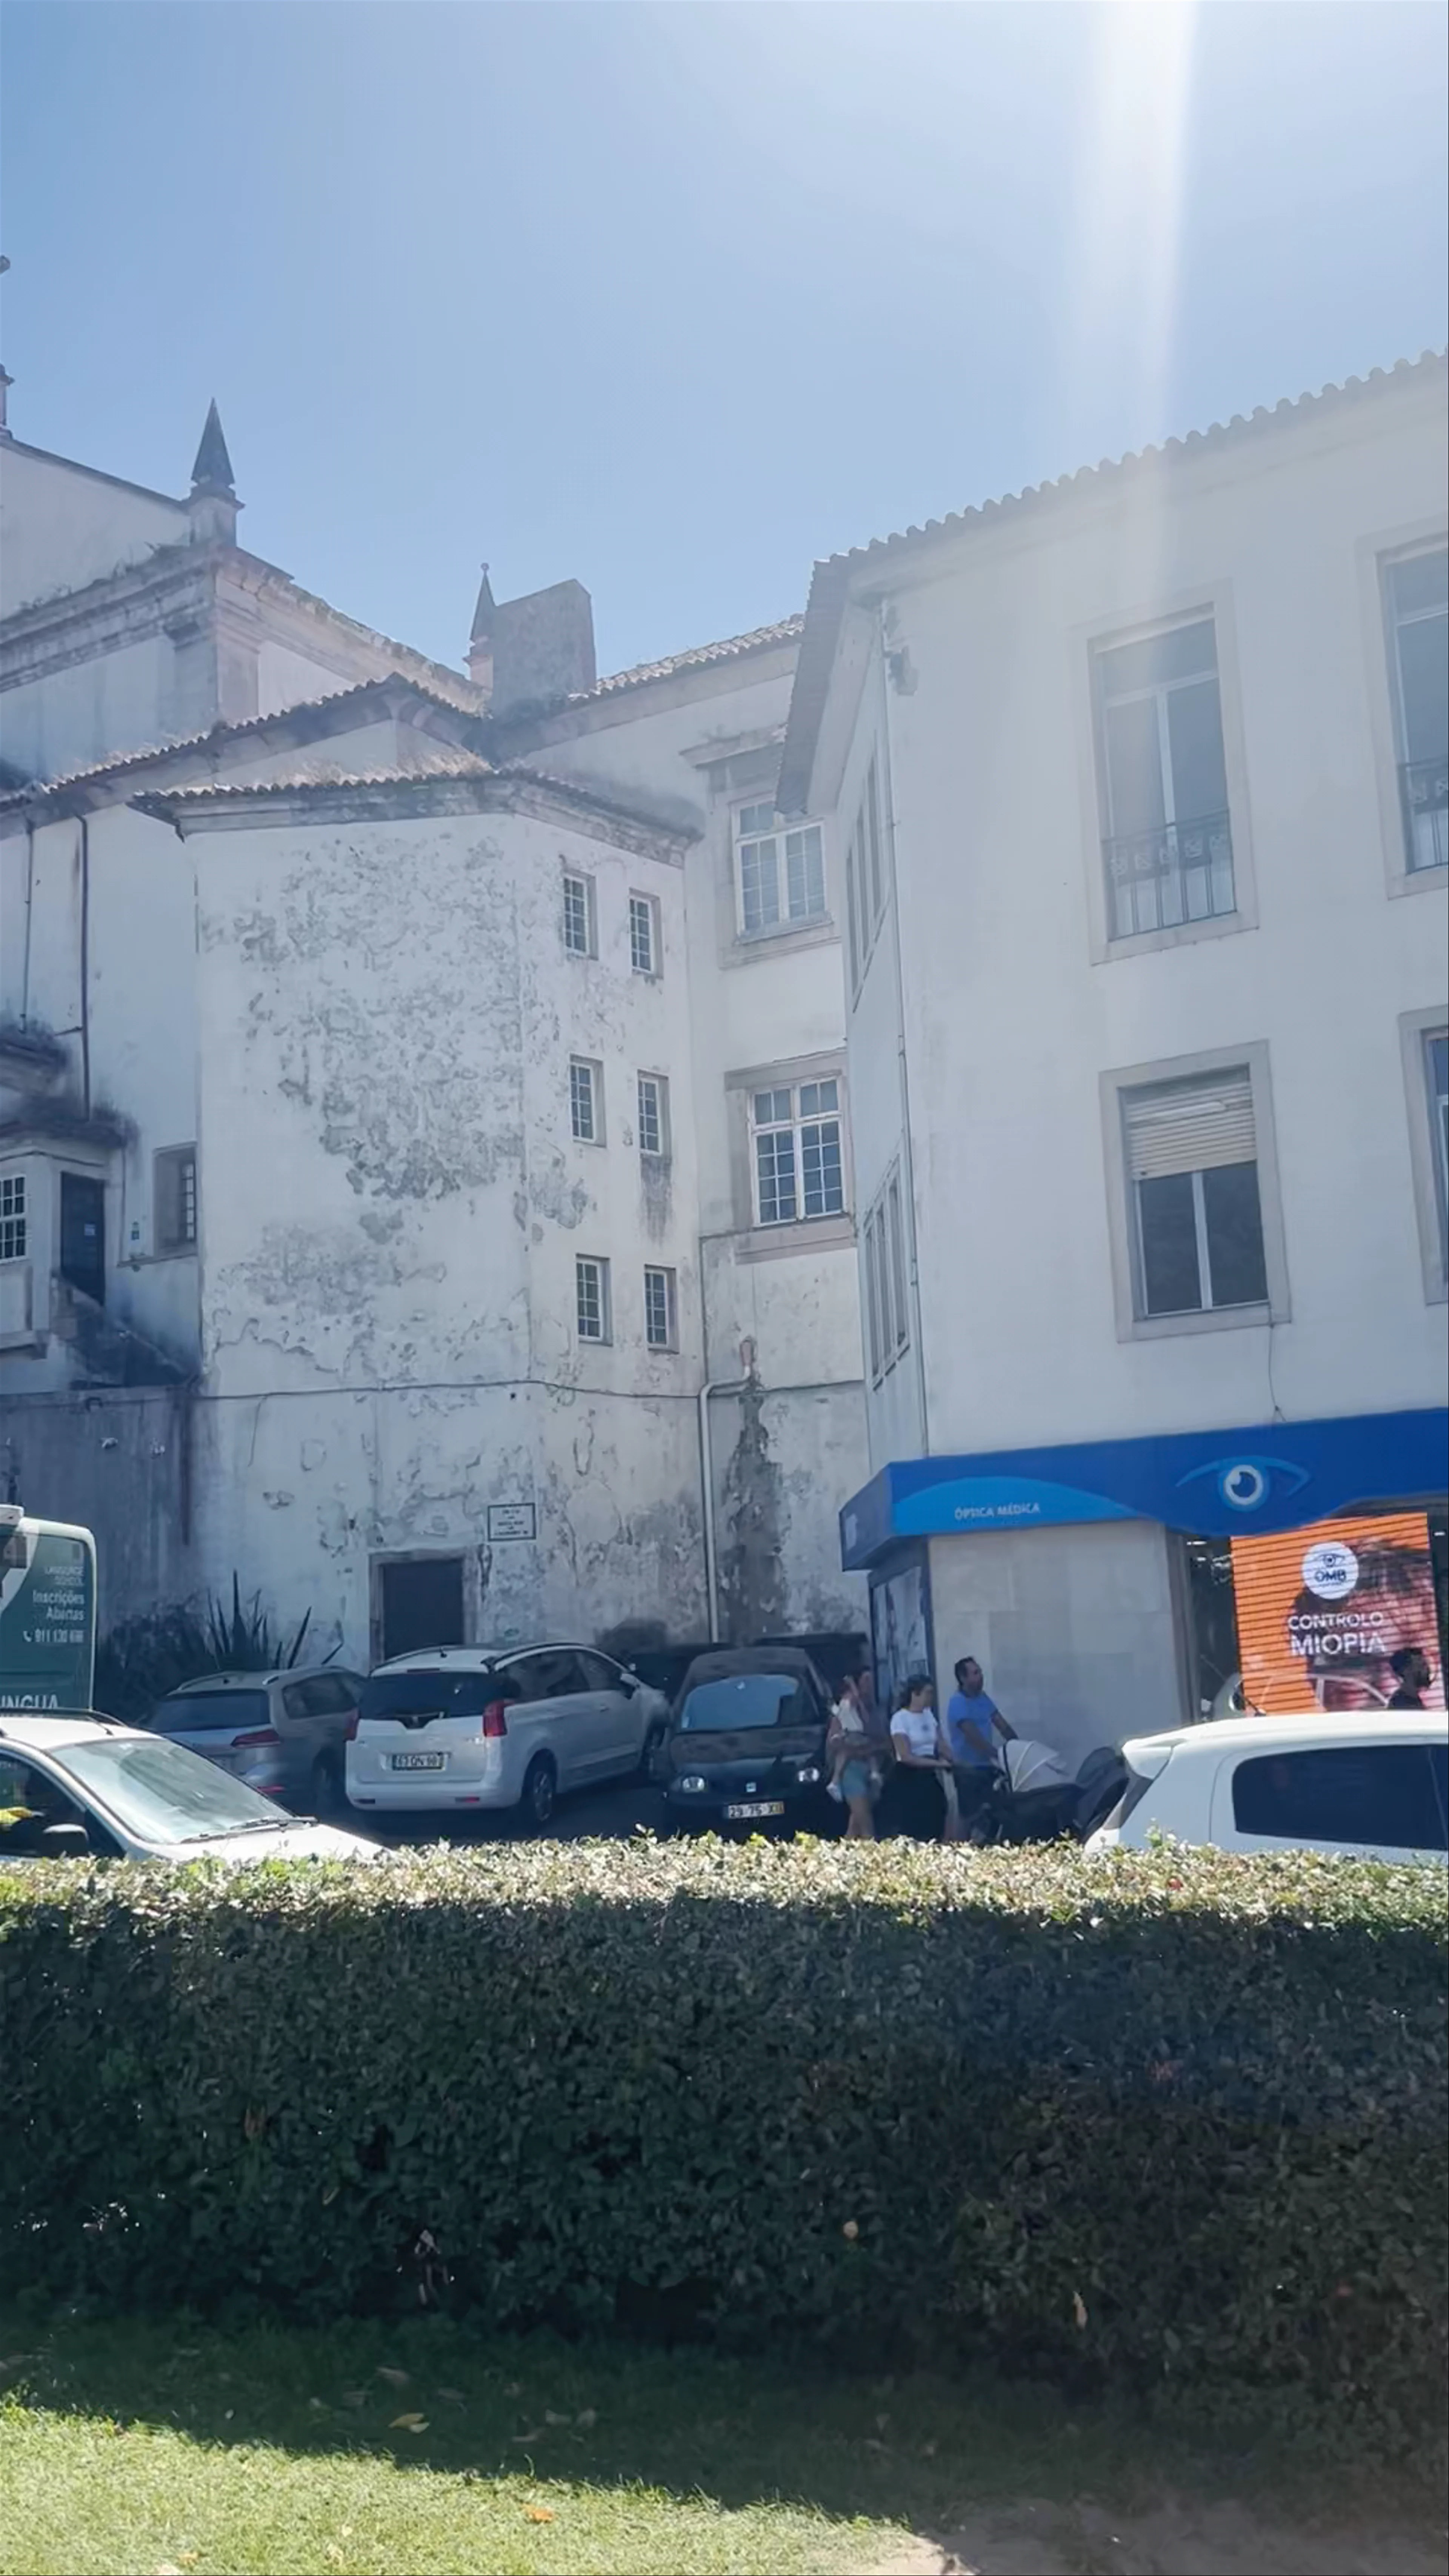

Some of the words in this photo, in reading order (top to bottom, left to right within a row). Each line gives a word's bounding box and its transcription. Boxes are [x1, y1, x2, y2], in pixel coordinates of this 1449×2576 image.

[1314, 1569, 1346, 1582] OMB
[1288, 1612, 1383, 1630] CONTROLO
[1290, 1632, 1388, 1656] MIOPIA
